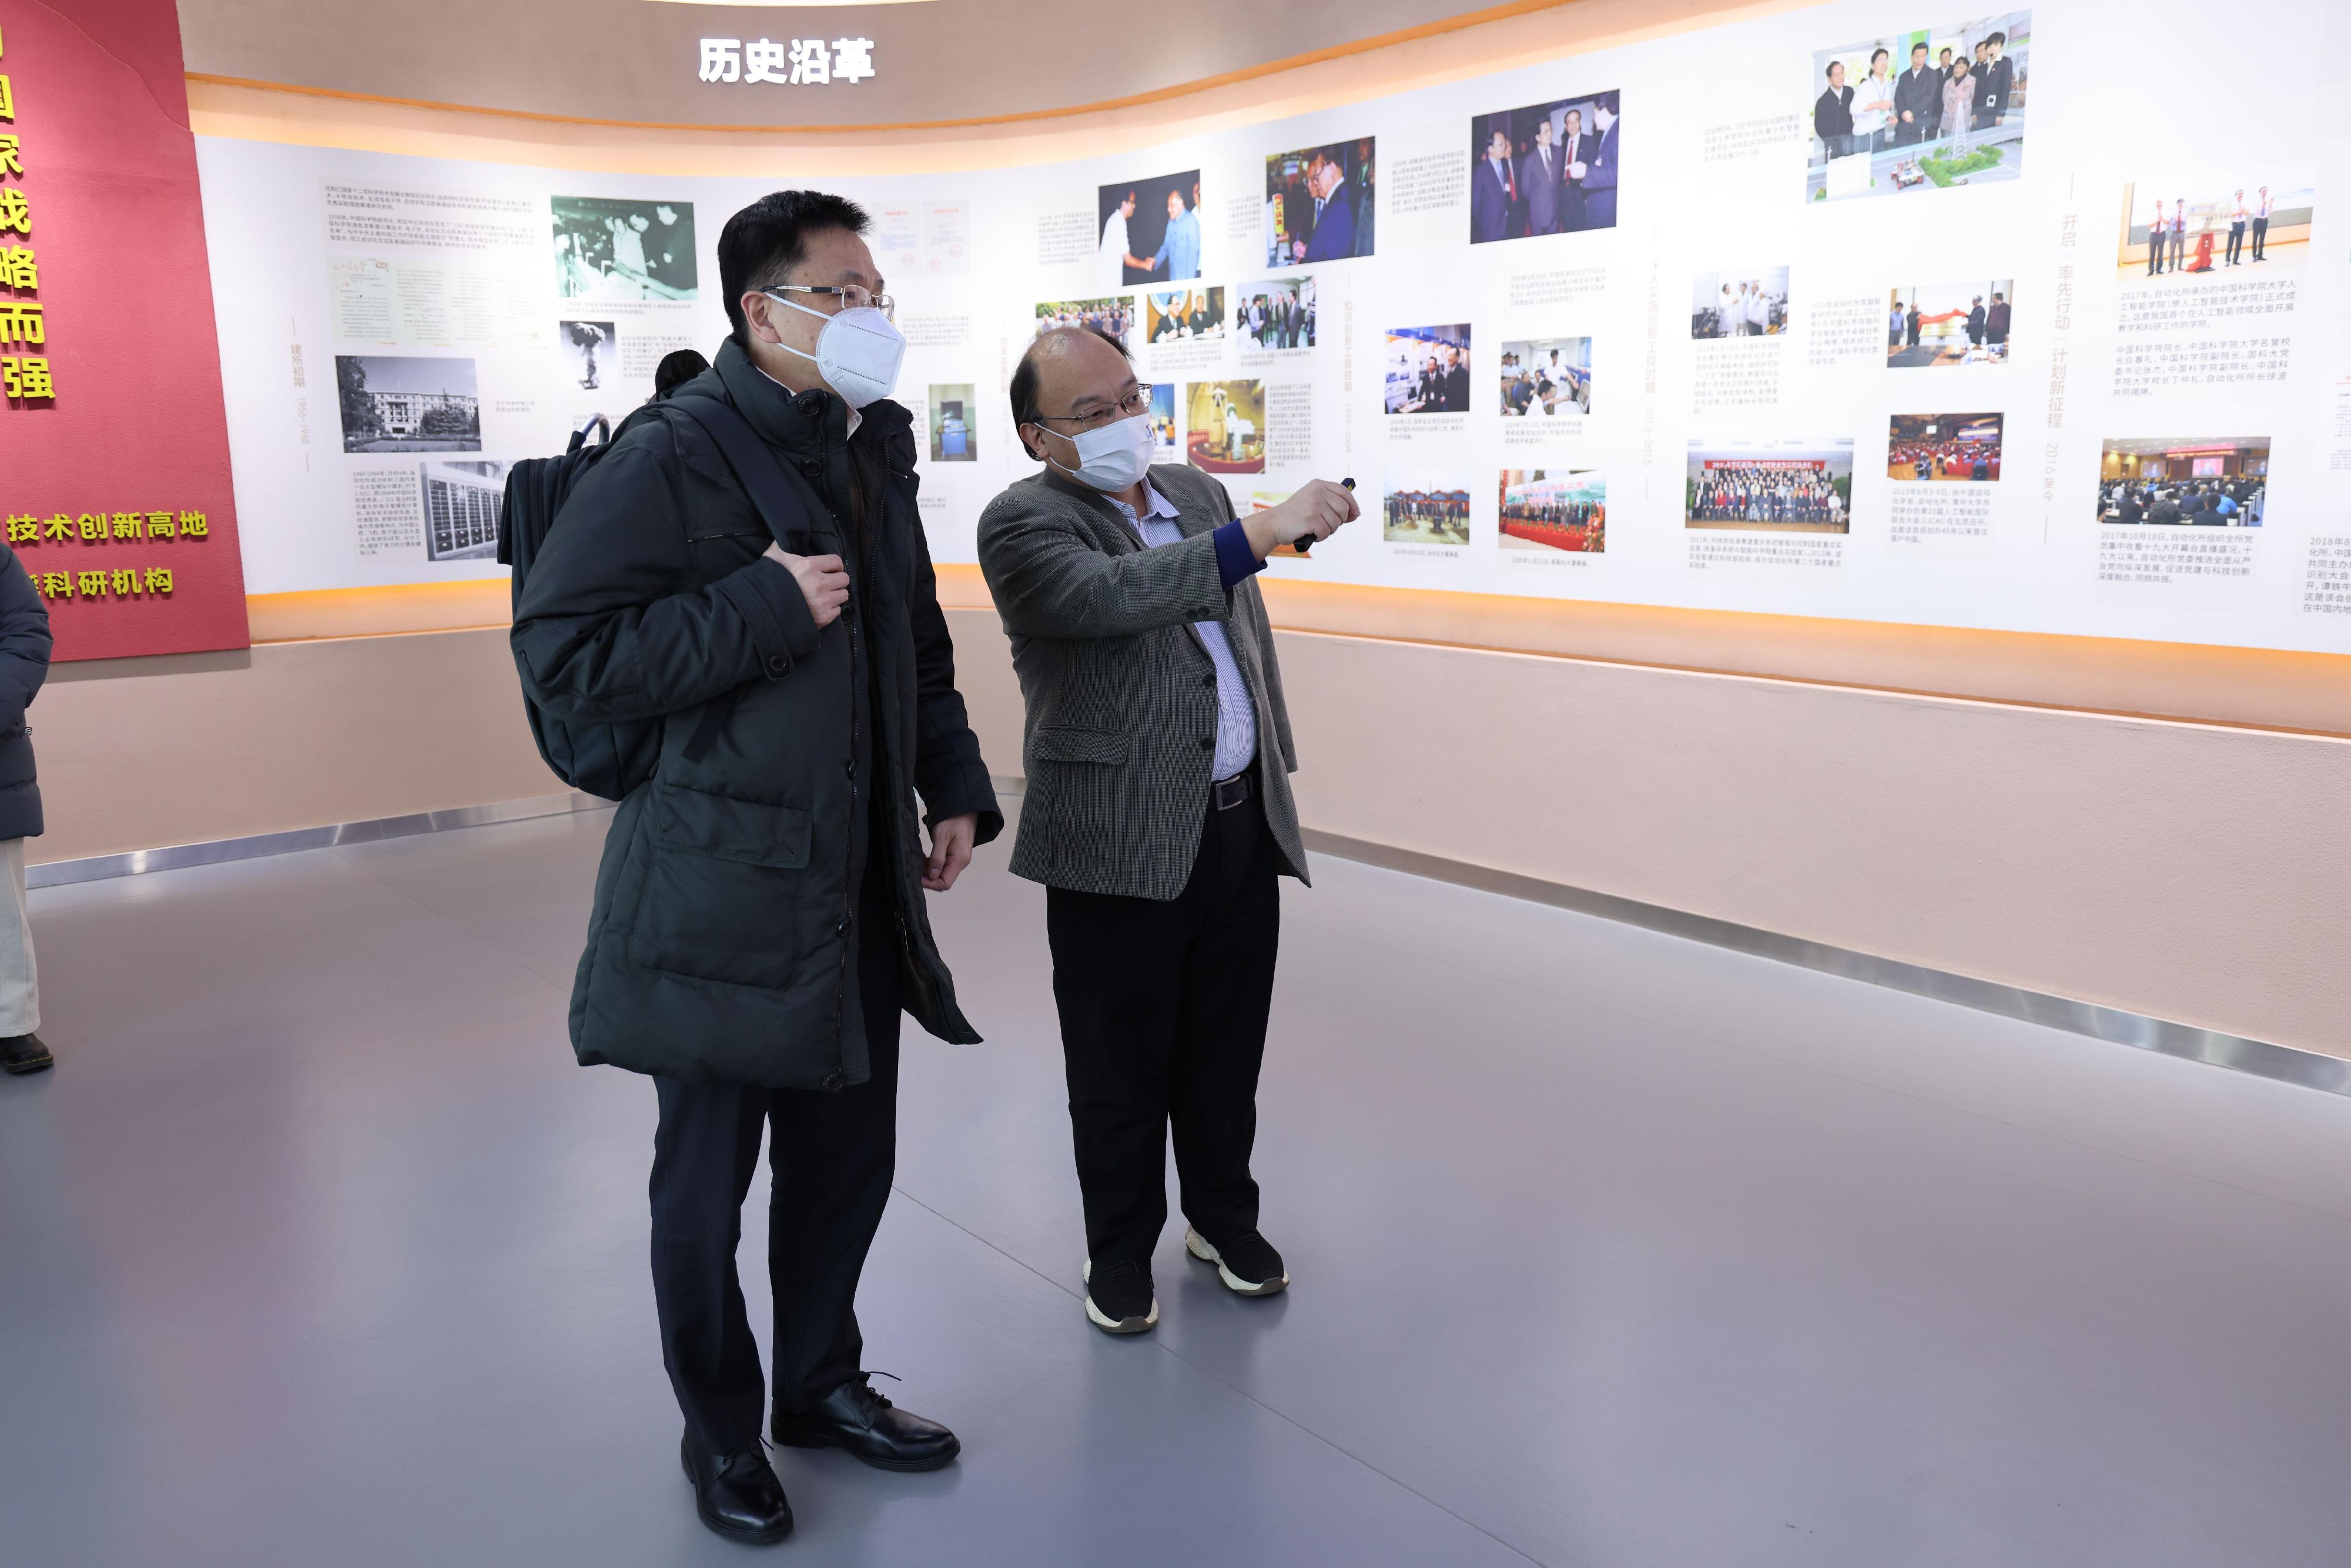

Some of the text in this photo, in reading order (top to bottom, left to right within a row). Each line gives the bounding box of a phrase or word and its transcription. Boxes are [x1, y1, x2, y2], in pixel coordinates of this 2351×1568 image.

[699, 38, 875, 85] 历史沿革
[0, 24, 56, 400] 战略而强
[2118, 320, 2210, 333] 教学和科研工作的学院。
[291, 344, 310, 444] 建所初期 1956-1968
[0, 510, 209, 542] 技术创新高地
[2310, 537, 2351, 545] 2018年8
[2308, 559, 2351, 568] 共同主办
[2306, 571, 2349, 579] 识别大会
